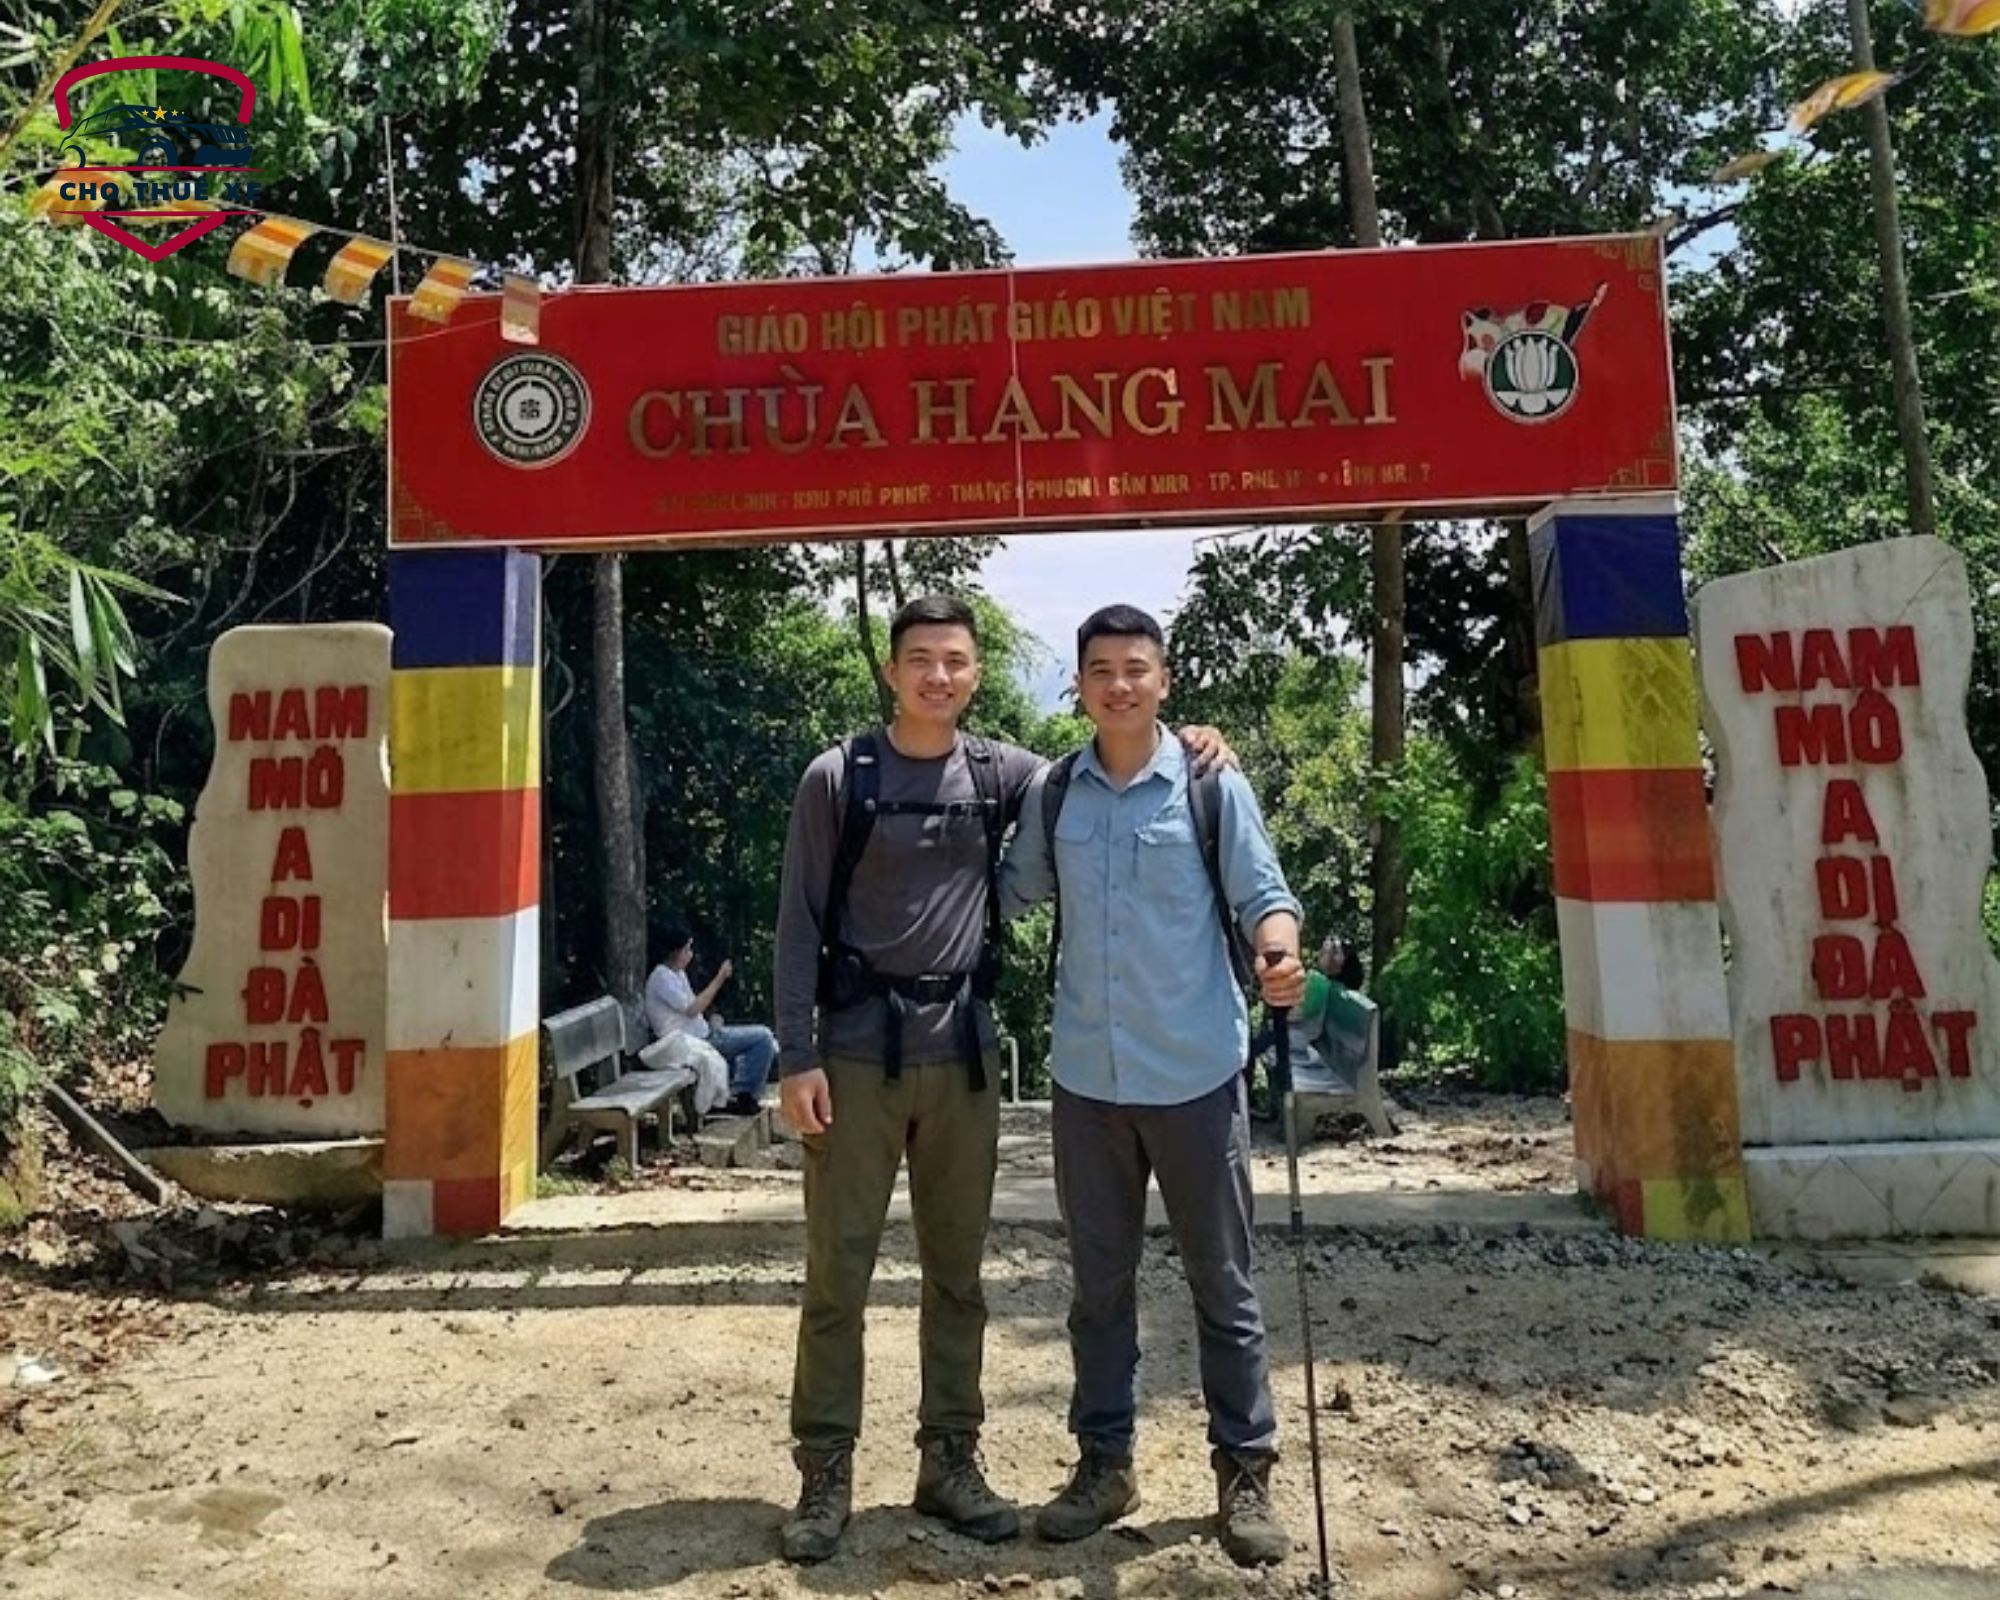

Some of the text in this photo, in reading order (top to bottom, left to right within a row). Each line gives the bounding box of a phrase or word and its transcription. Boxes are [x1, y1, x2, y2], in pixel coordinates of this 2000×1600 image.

[718, 304, 808, 355] GIÁO
[821, 300, 886, 357] HỘI
[1007, 289, 1102, 341] GIÁO
[1111, 287, 1197, 341] VIỆT
[1212, 287, 1311, 330] NAM
[627, 364, 887, 459] CHÙA
[910, 367, 1185, 443] HANG
[1204, 357, 1397, 432] MAI
[1734, 626, 1920, 693] NAM
[229, 686, 368, 741] NAM
[1775, 689, 1903, 766] MÔ
[248, 745, 344, 811] MÔ
[1823, 779, 1878, 846] A
[271, 826, 313, 881] A
[260, 895, 321, 951] DI
[242, 956, 329, 1025] ĐÀ
[206, 1027, 365, 1108] PHẬT
[1771, 998, 1977, 1092] PHẬT
